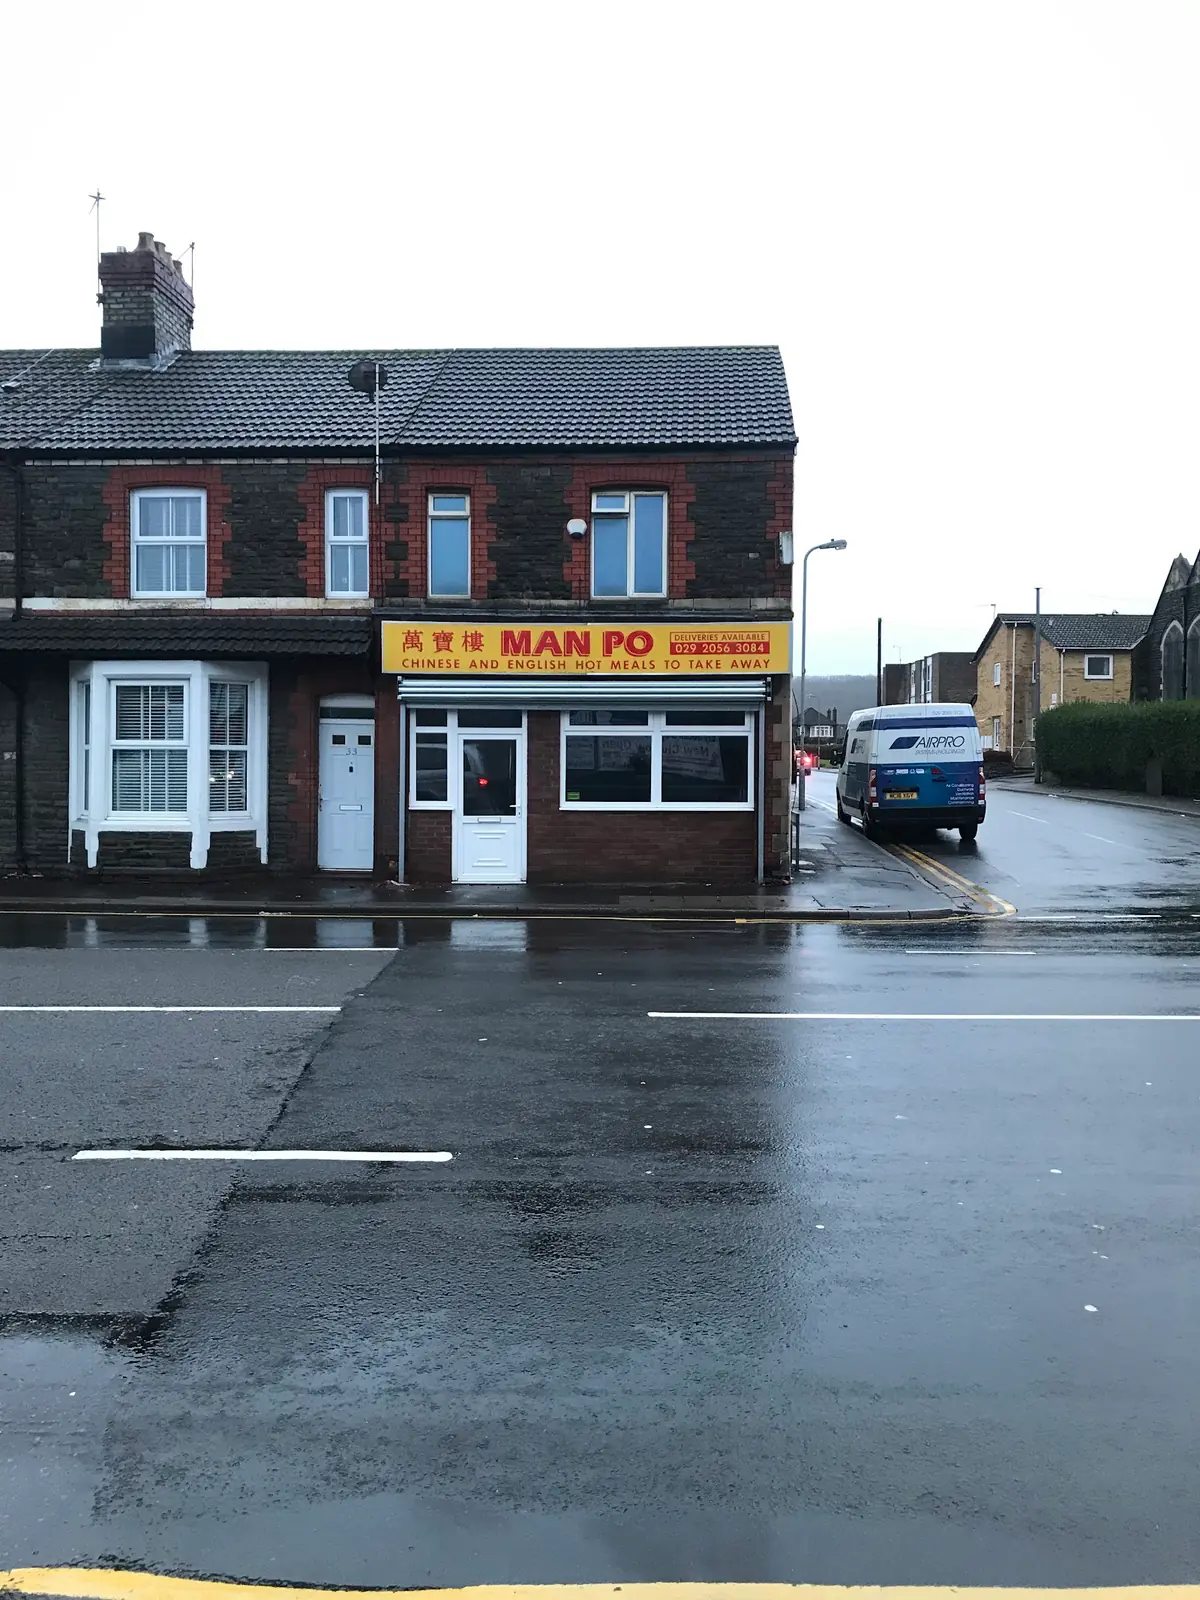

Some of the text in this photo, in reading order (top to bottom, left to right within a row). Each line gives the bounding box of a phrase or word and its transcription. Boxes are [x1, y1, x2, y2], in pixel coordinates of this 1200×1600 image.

[402, 629, 485, 653] 萬寶樓
[721, 633, 766, 641] AVAILABLE
[500, 630, 654, 657] MAN PO
[675, 643, 764, 653] 029 2056 3084
[401, 658, 771, 670] CHINESE AND ENGLISH HOT MEALS TO TAKE AWAY
[915, 736, 965, 748] AIRPRO
[346, 748, 358, 756] 33
